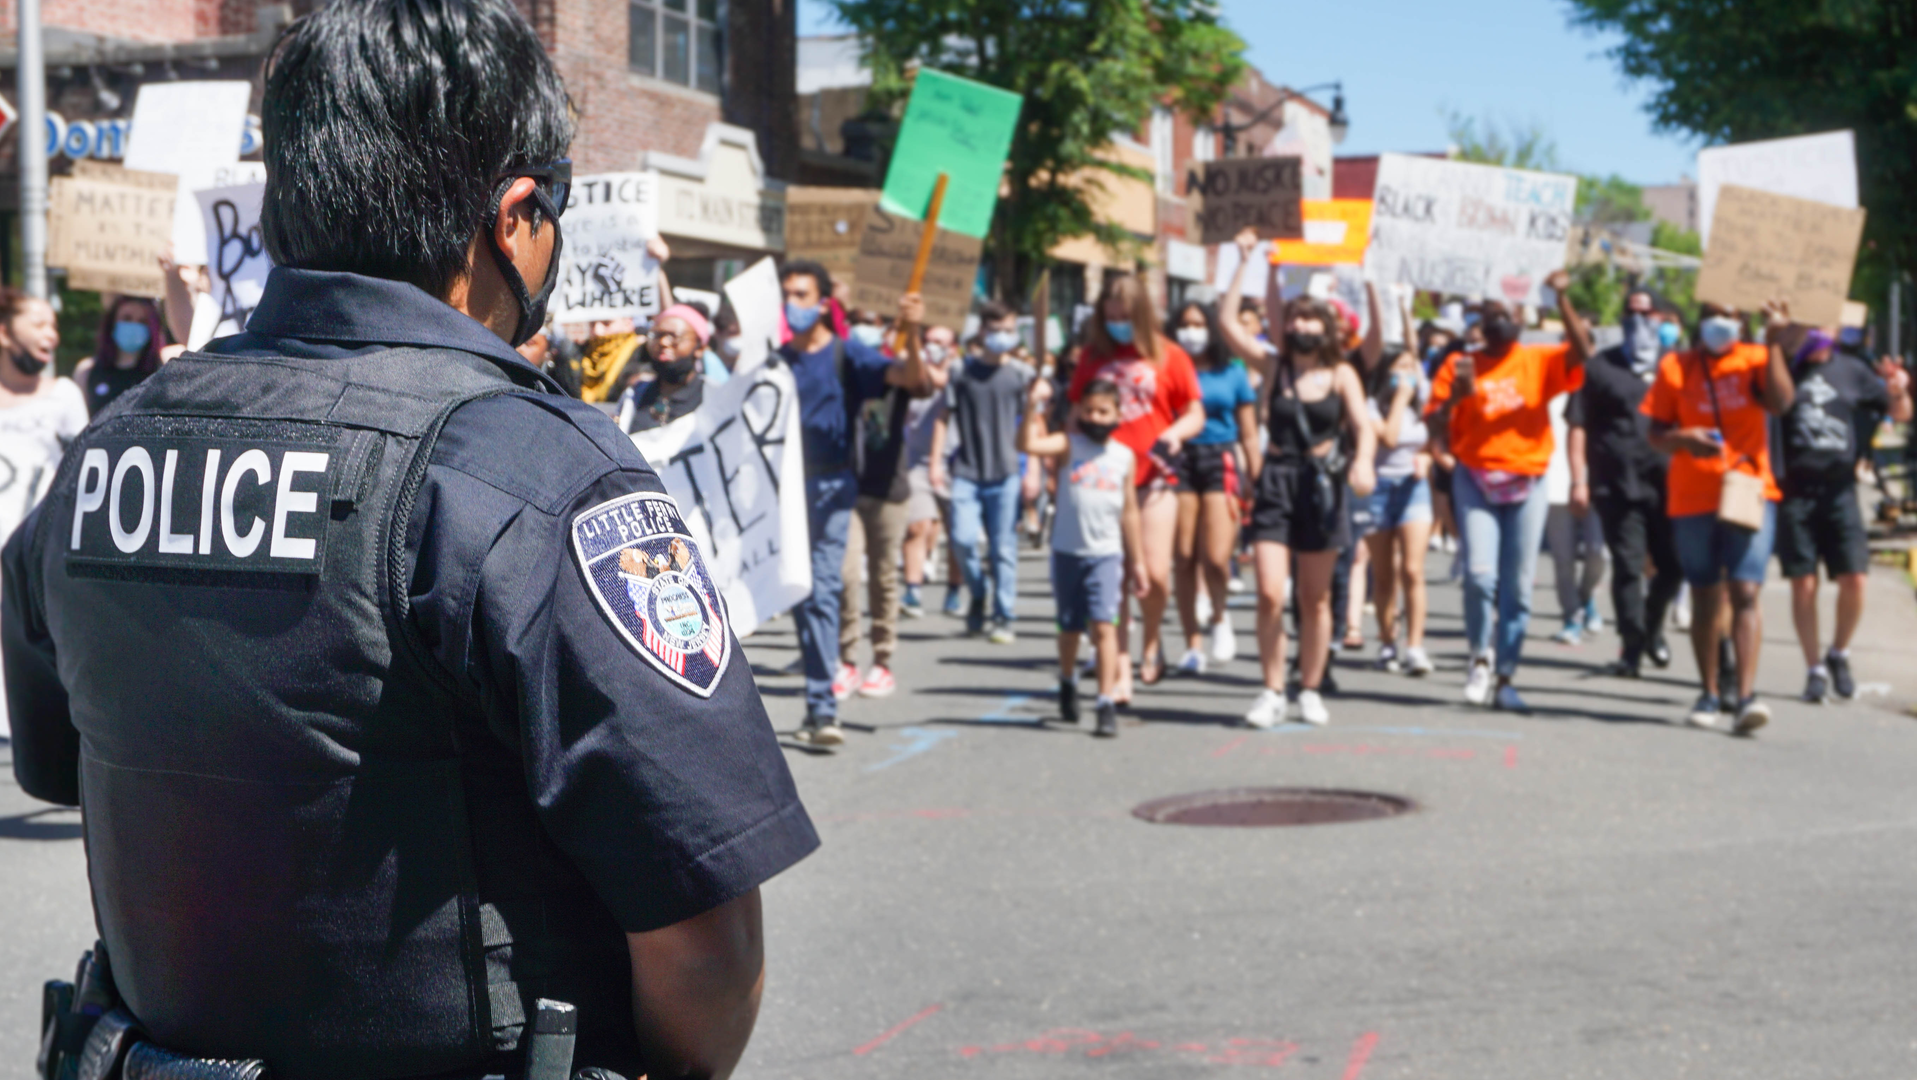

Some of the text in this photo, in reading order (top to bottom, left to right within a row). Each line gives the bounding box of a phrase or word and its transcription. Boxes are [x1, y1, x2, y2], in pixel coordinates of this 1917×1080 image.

[1187, 164, 1230, 197] NO
[1502, 172, 1570, 208] TEACH
[1196, 211, 1230, 234] NO
[1376, 184, 1438, 225] BLACK
[1526, 208, 1572, 243] KIDS
[565, 286, 653, 311] WHERE
[669, 381, 785, 558] TER
[70, 445, 320, 560] POLICE
[583, 500, 680, 539] LITTLE FERRY
[617, 516, 675, 543] POLICE
[651, 573, 673, 596] STATE
[662, 631, 685, 650] NEW
